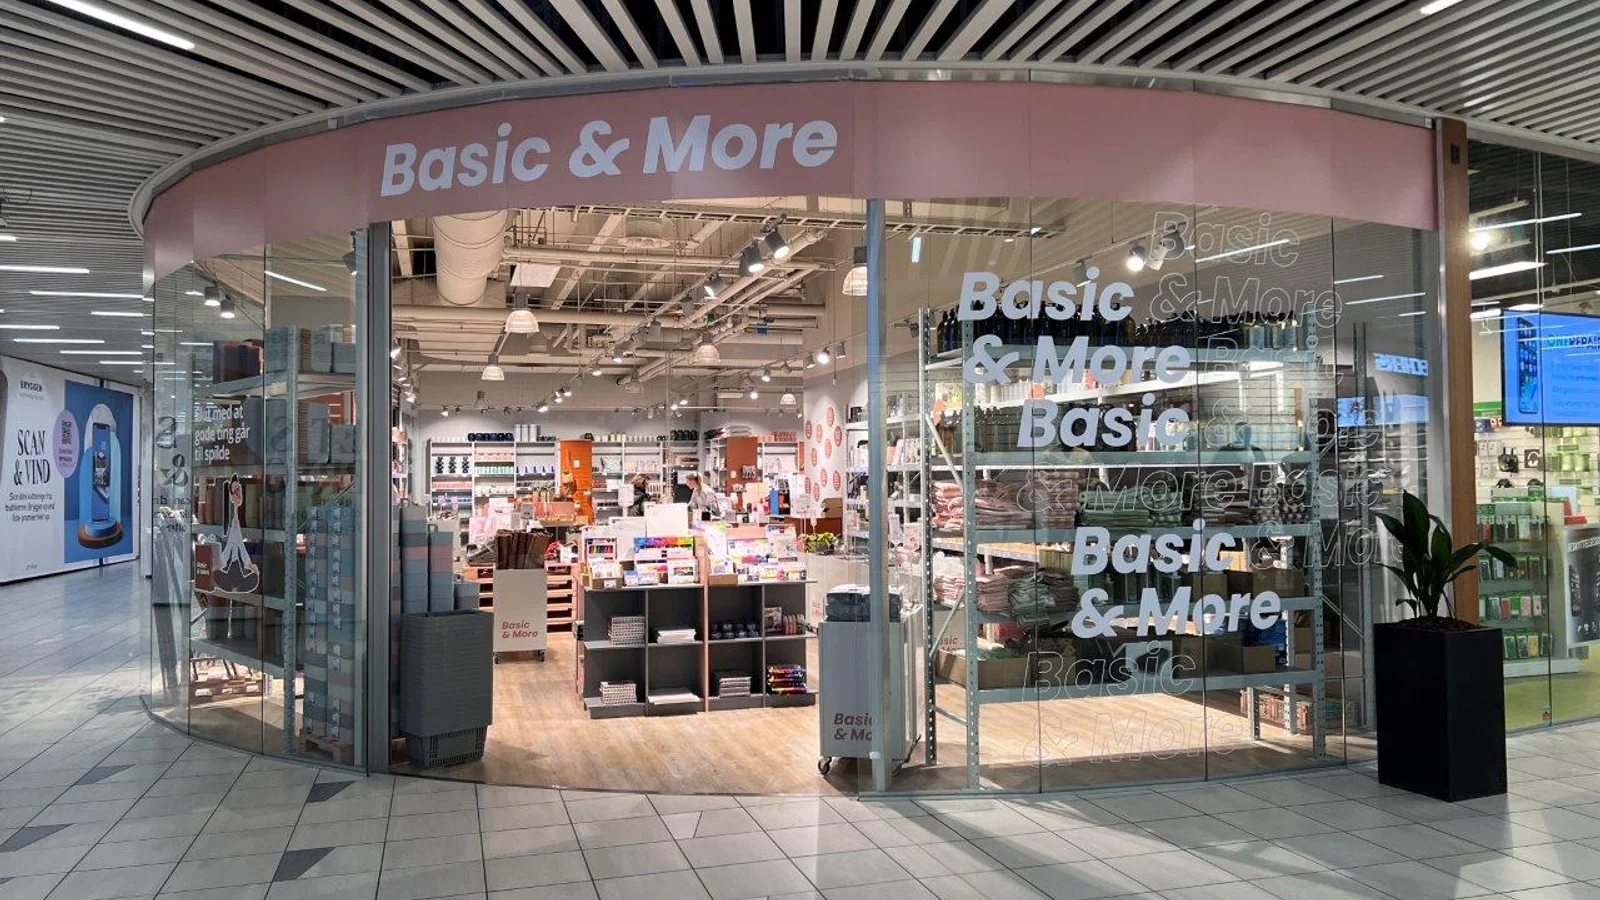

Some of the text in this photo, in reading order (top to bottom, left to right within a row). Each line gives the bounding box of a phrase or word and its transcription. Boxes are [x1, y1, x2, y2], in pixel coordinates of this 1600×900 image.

[380, 115, 838, 197] Basic & More
[1149, 212, 1299, 267] Basic
[958, 267, 1343, 328] Basic & More
[963, 334, 1020, 384] &
[1032, 335, 1191, 384] More
[195, 422, 250, 445] gode ting går
[213, 404, 232, 420] med
[233, 404, 244, 419] at
[1017, 393, 1190, 448] Basic
[17, 428, 46, 456] SCAN
[195, 444, 230, 465] til spilde
[14, 459, 51, 486] & VIND
[1084, 462, 1238, 512] More
[1071, 519, 1236, 576] Basic
[502, 620, 530, 630] Basic
[502, 630, 539, 639] & More
[1072, 586, 1282, 639] & More
[1022, 640, 1196, 703] Basic
[834, 727, 847, 741] &
[1090, 711, 1245, 764] More
